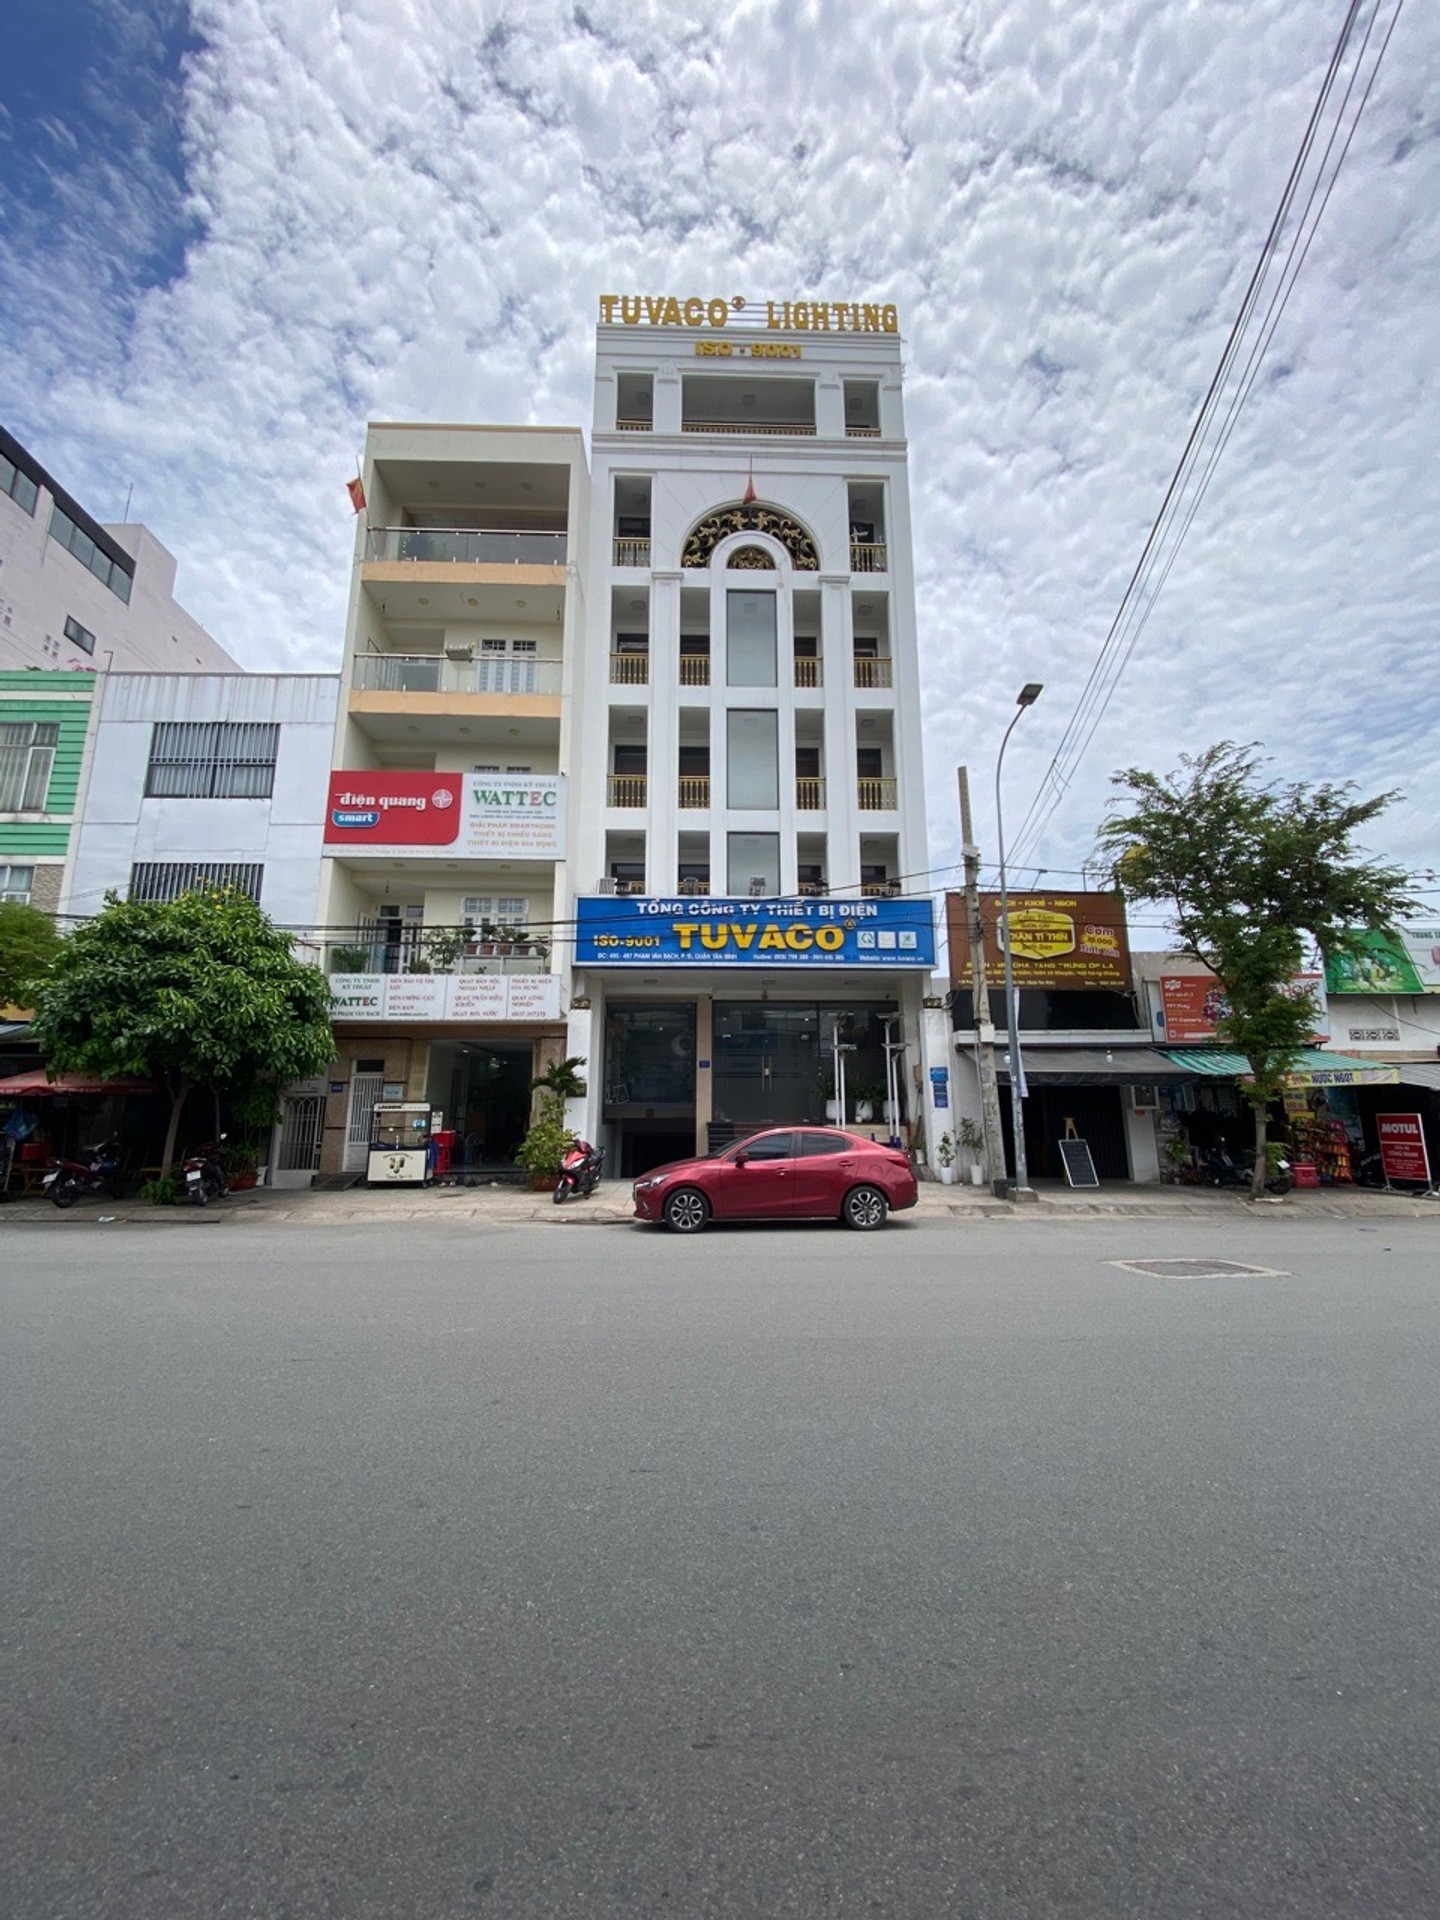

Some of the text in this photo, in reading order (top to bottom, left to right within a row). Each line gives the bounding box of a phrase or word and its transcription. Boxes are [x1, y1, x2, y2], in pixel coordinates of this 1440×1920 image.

[599, 295, 898, 332] TUVACO LIGHTING
[695, 341, 733, 357] ISO
[378, 796, 426, 811] quang
[473, 789, 557, 806] WATTEC
[338, 813, 374, 822] smart
[636, 898, 878, 919] TỔNG CÔNG TY THIẾT BỊ ĐIỆN
[672, 922, 845, 950] TUVACO
[330, 996, 378, 1007] WATTEC
[1381, 1123, 1419, 1134] MOTUL
